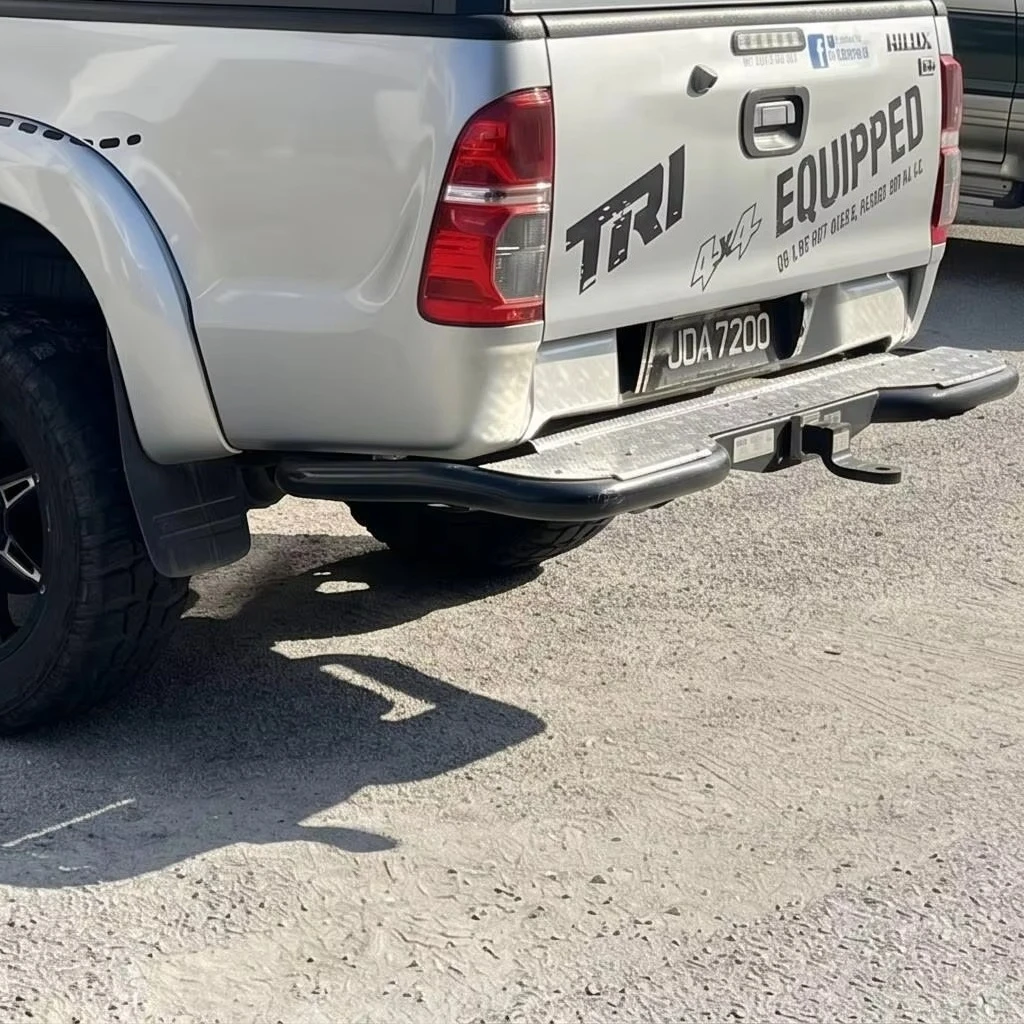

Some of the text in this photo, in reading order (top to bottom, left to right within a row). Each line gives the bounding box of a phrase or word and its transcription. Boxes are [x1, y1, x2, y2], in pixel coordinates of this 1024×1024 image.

[565, 85, 924, 295] TRI EQUIPPED
[667, 311, 771, 370] JDA 7200
